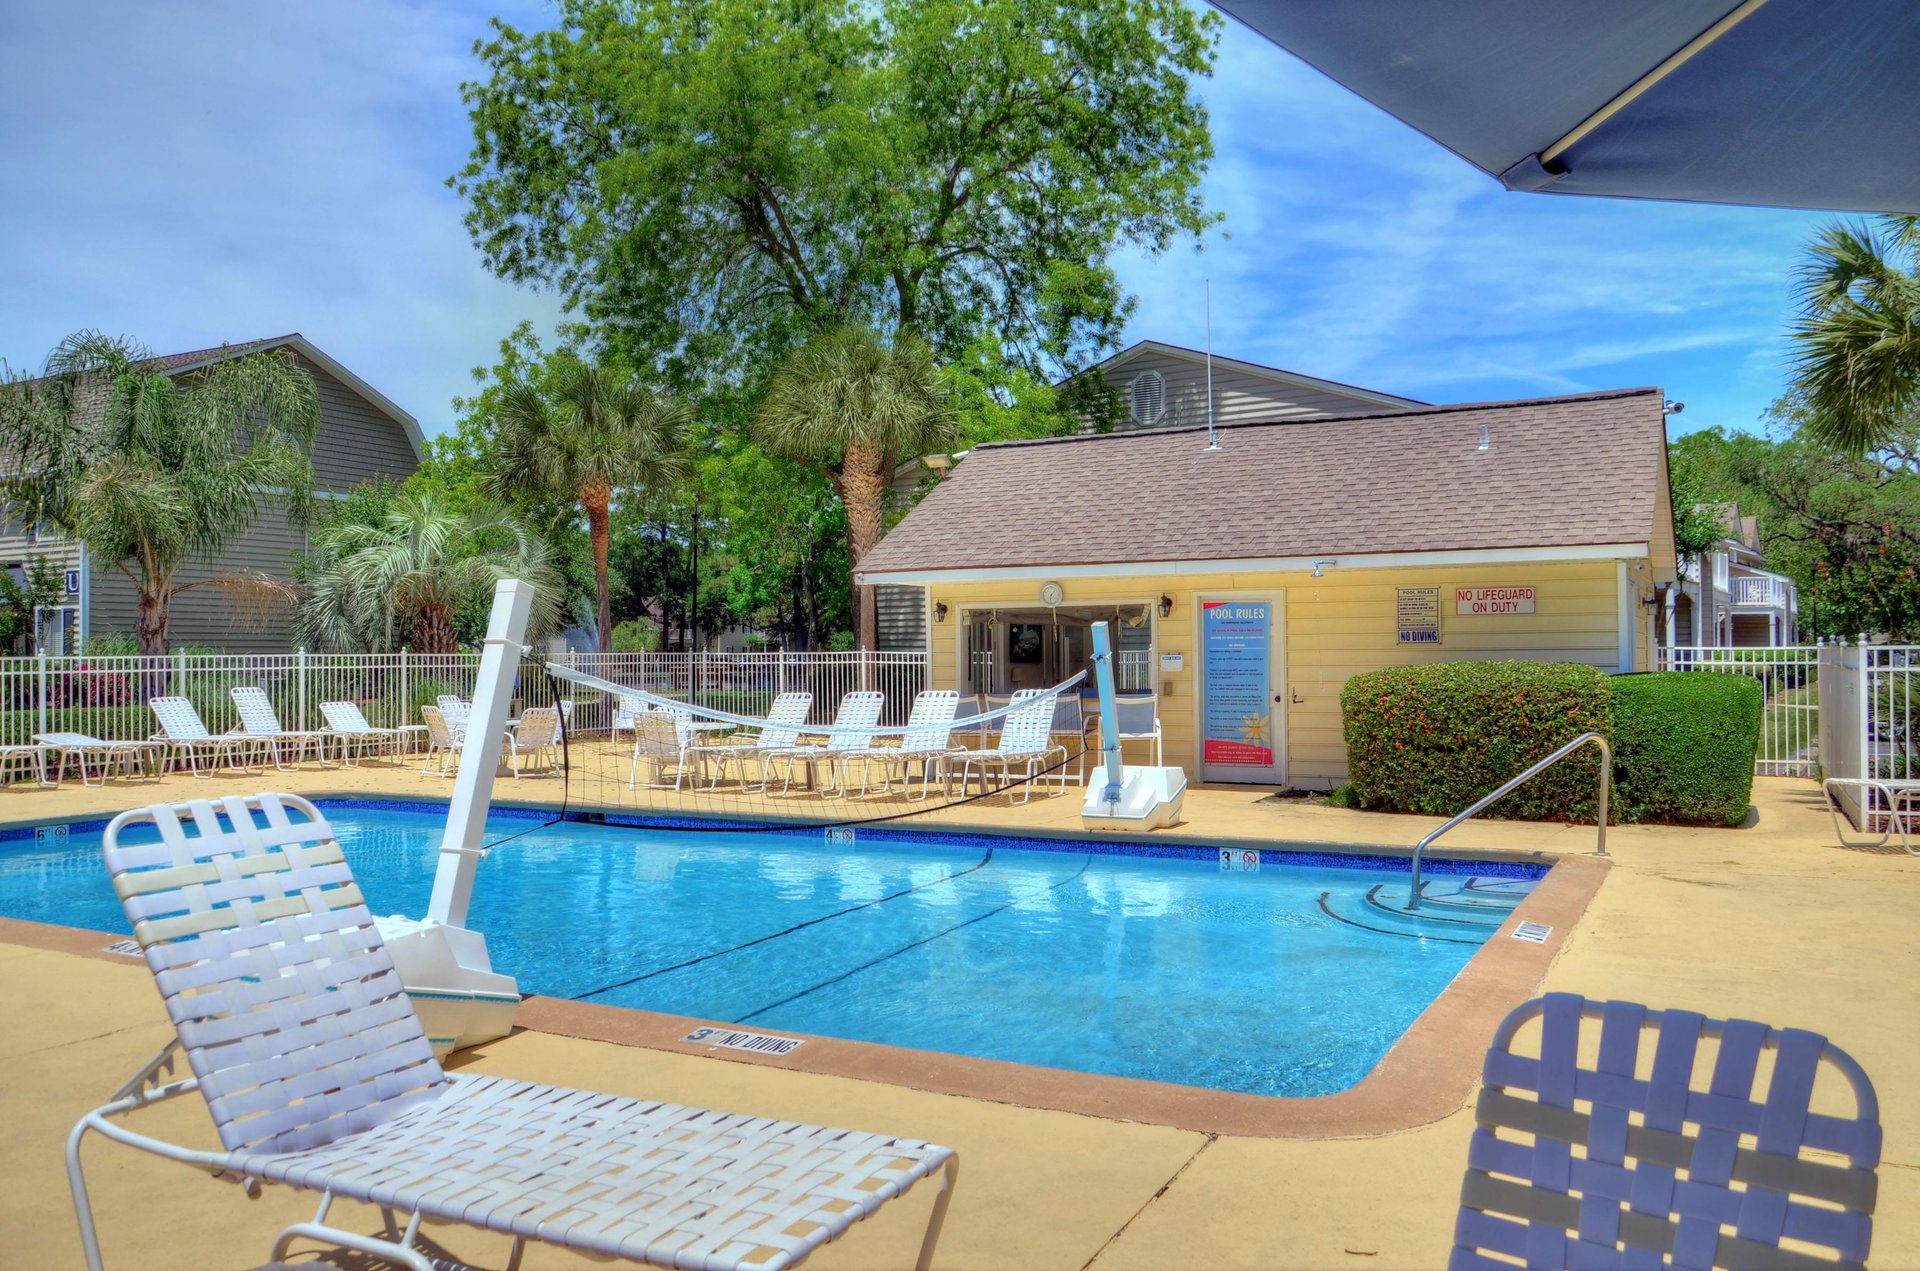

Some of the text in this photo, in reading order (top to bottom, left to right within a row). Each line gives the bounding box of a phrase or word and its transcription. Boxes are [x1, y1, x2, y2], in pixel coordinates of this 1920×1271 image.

[67, 573, 79, 591] U
[1458, 588, 1533, 601] NO LIFEGUARD
[1472, 601, 1519, 613] ON DUTY
[1210, 607, 1265, 620] POOL RULES
[1400, 631, 1438, 641] NO DIVING
[37, 829, 46, 840] 6
[1221, 851, 1231, 862] 3
[687, 1028, 714, 1041] 3
[719, 1032, 746, 1046] NO
[743, 1036, 798, 1053] DIVING
